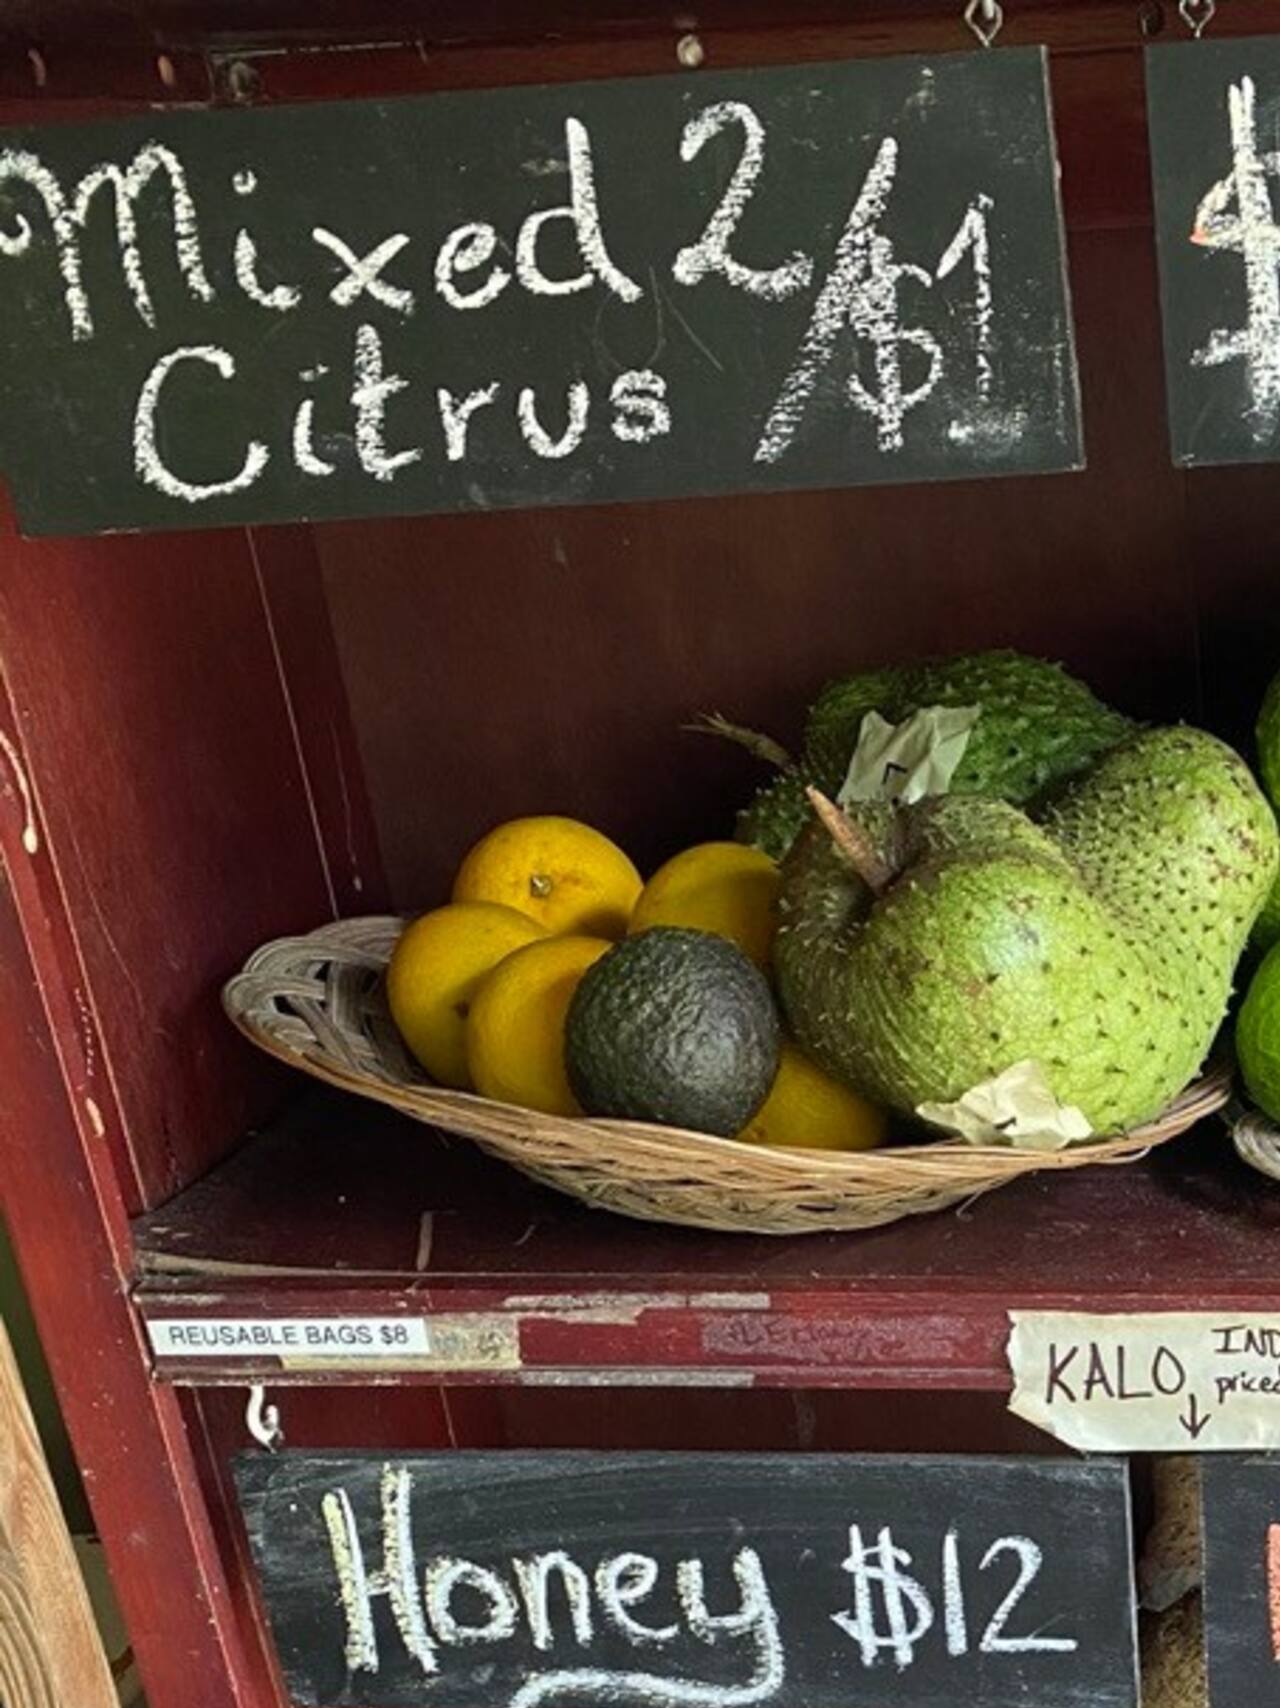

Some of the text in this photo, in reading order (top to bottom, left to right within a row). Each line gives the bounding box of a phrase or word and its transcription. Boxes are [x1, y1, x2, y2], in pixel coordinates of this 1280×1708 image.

[0, 117, 643, 342] Mixed
[132, 324, 672, 502] Citrus
[168, 1325, 298, 1346] REUSABLE
[306, 1325, 373, 1345] BAGS
[1046, 1341, 1186, 1405] KALO
[830, 1524, 1077, 1668] $12
